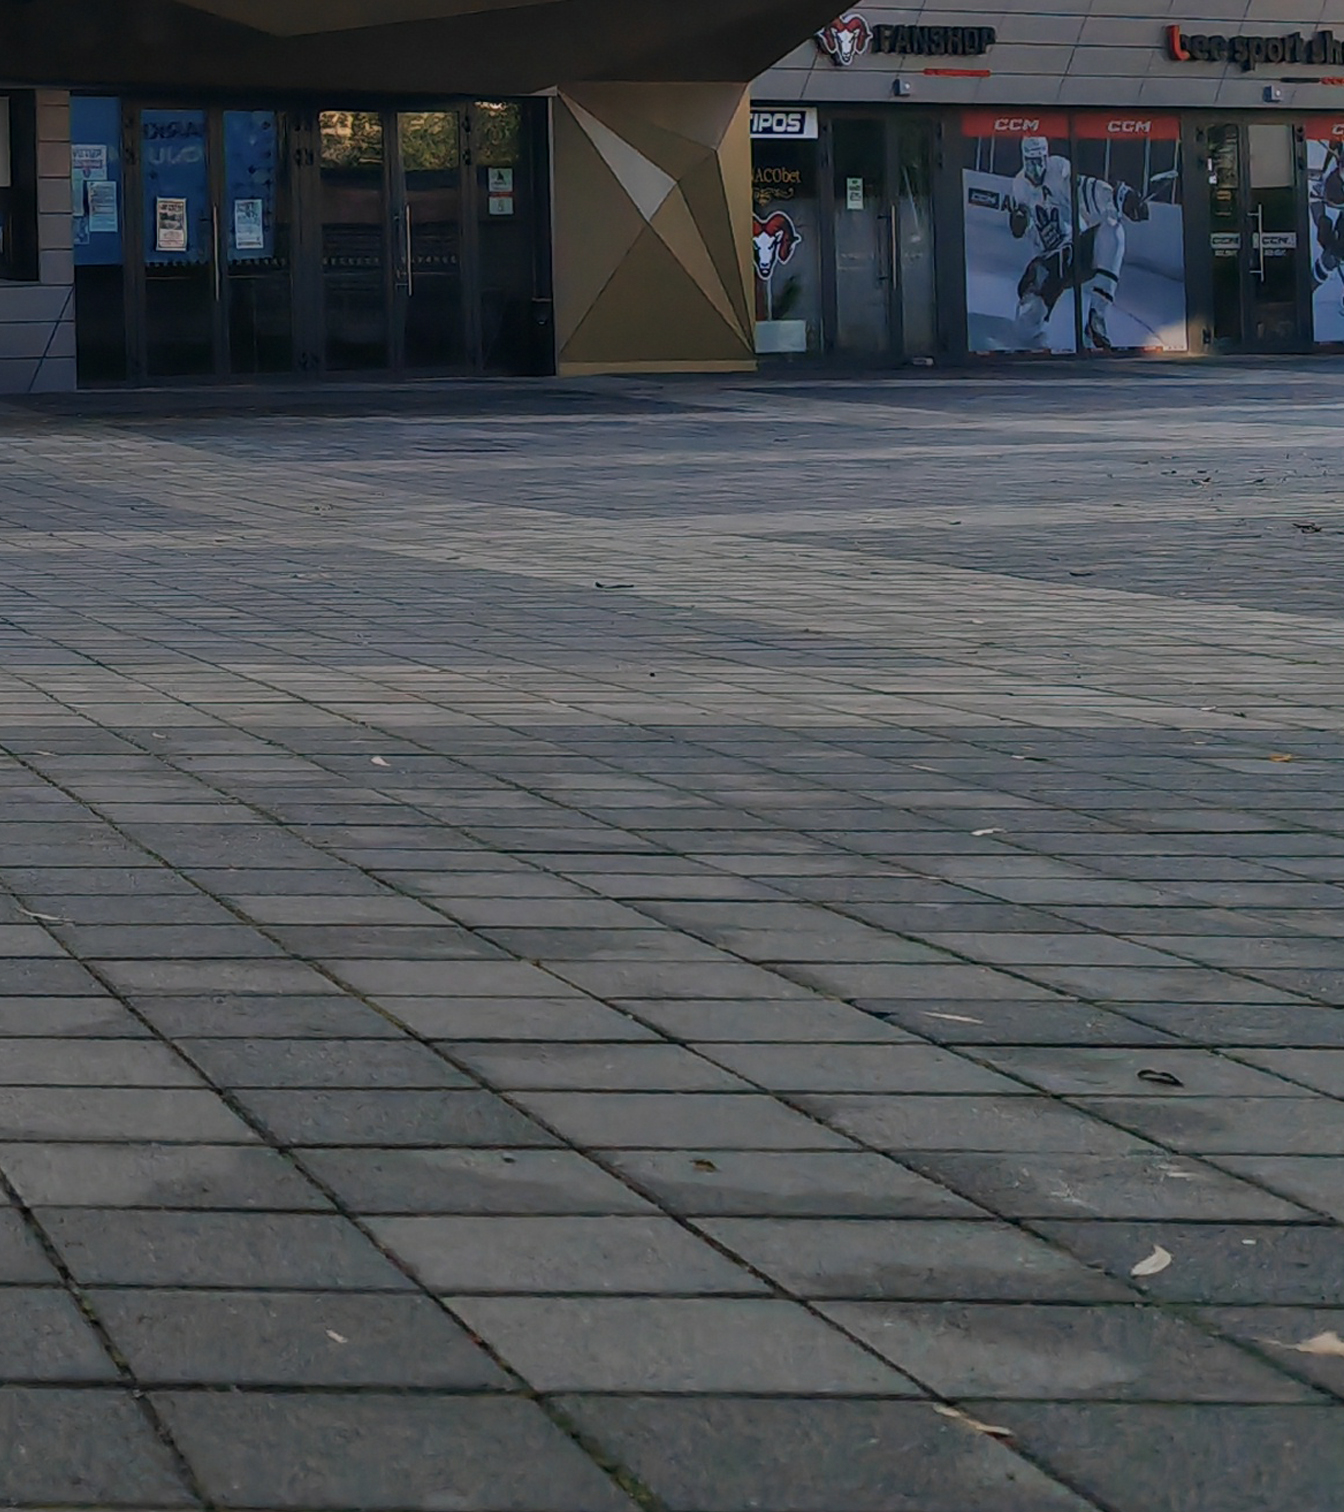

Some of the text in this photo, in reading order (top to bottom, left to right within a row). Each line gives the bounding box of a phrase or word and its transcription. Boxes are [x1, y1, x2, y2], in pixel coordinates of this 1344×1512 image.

[872, 24, 996, 55] FANSHOP
[1229, 32, 1303, 71] sport
[750, 112, 802, 133] IPOS
[994, 117, 1040, 131] CCM
[1107, 120, 1152, 133] CCM
[754, 167, 802, 183] ACObet
